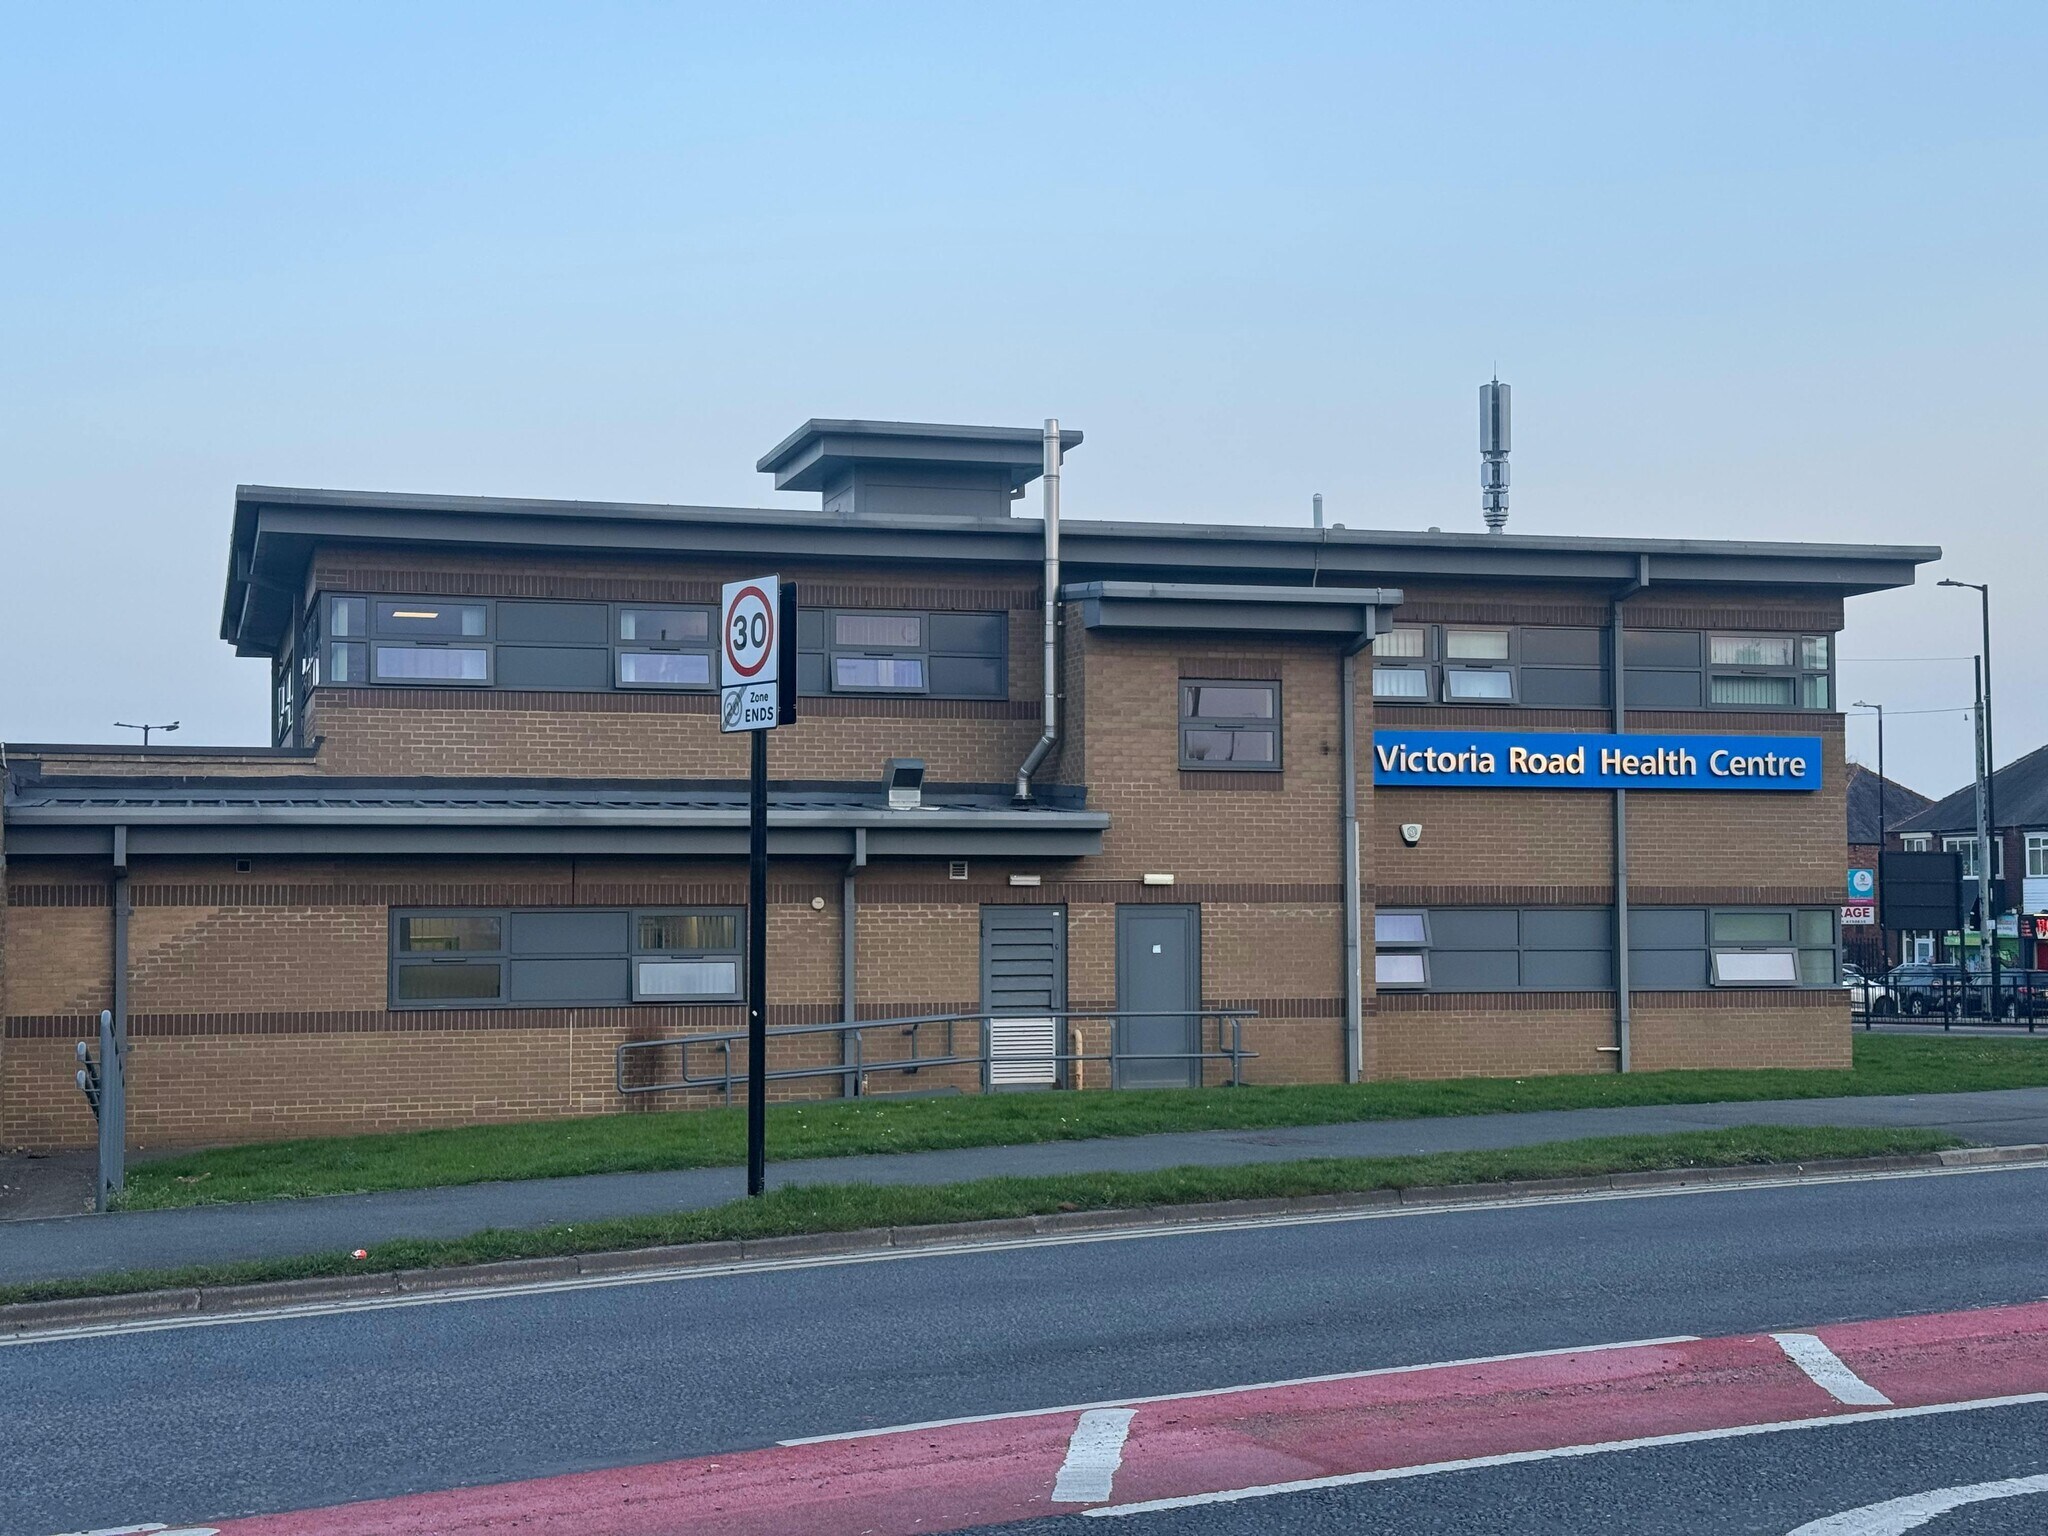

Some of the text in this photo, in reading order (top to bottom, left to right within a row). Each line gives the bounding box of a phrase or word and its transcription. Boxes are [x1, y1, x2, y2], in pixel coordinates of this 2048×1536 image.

[733, 611, 767, 651] 30
[750, 691, 769, 703] Zone
[745, 706, 774, 722] ENDS
[1376, 744, 1806, 777] Victoria Road Health Centre
